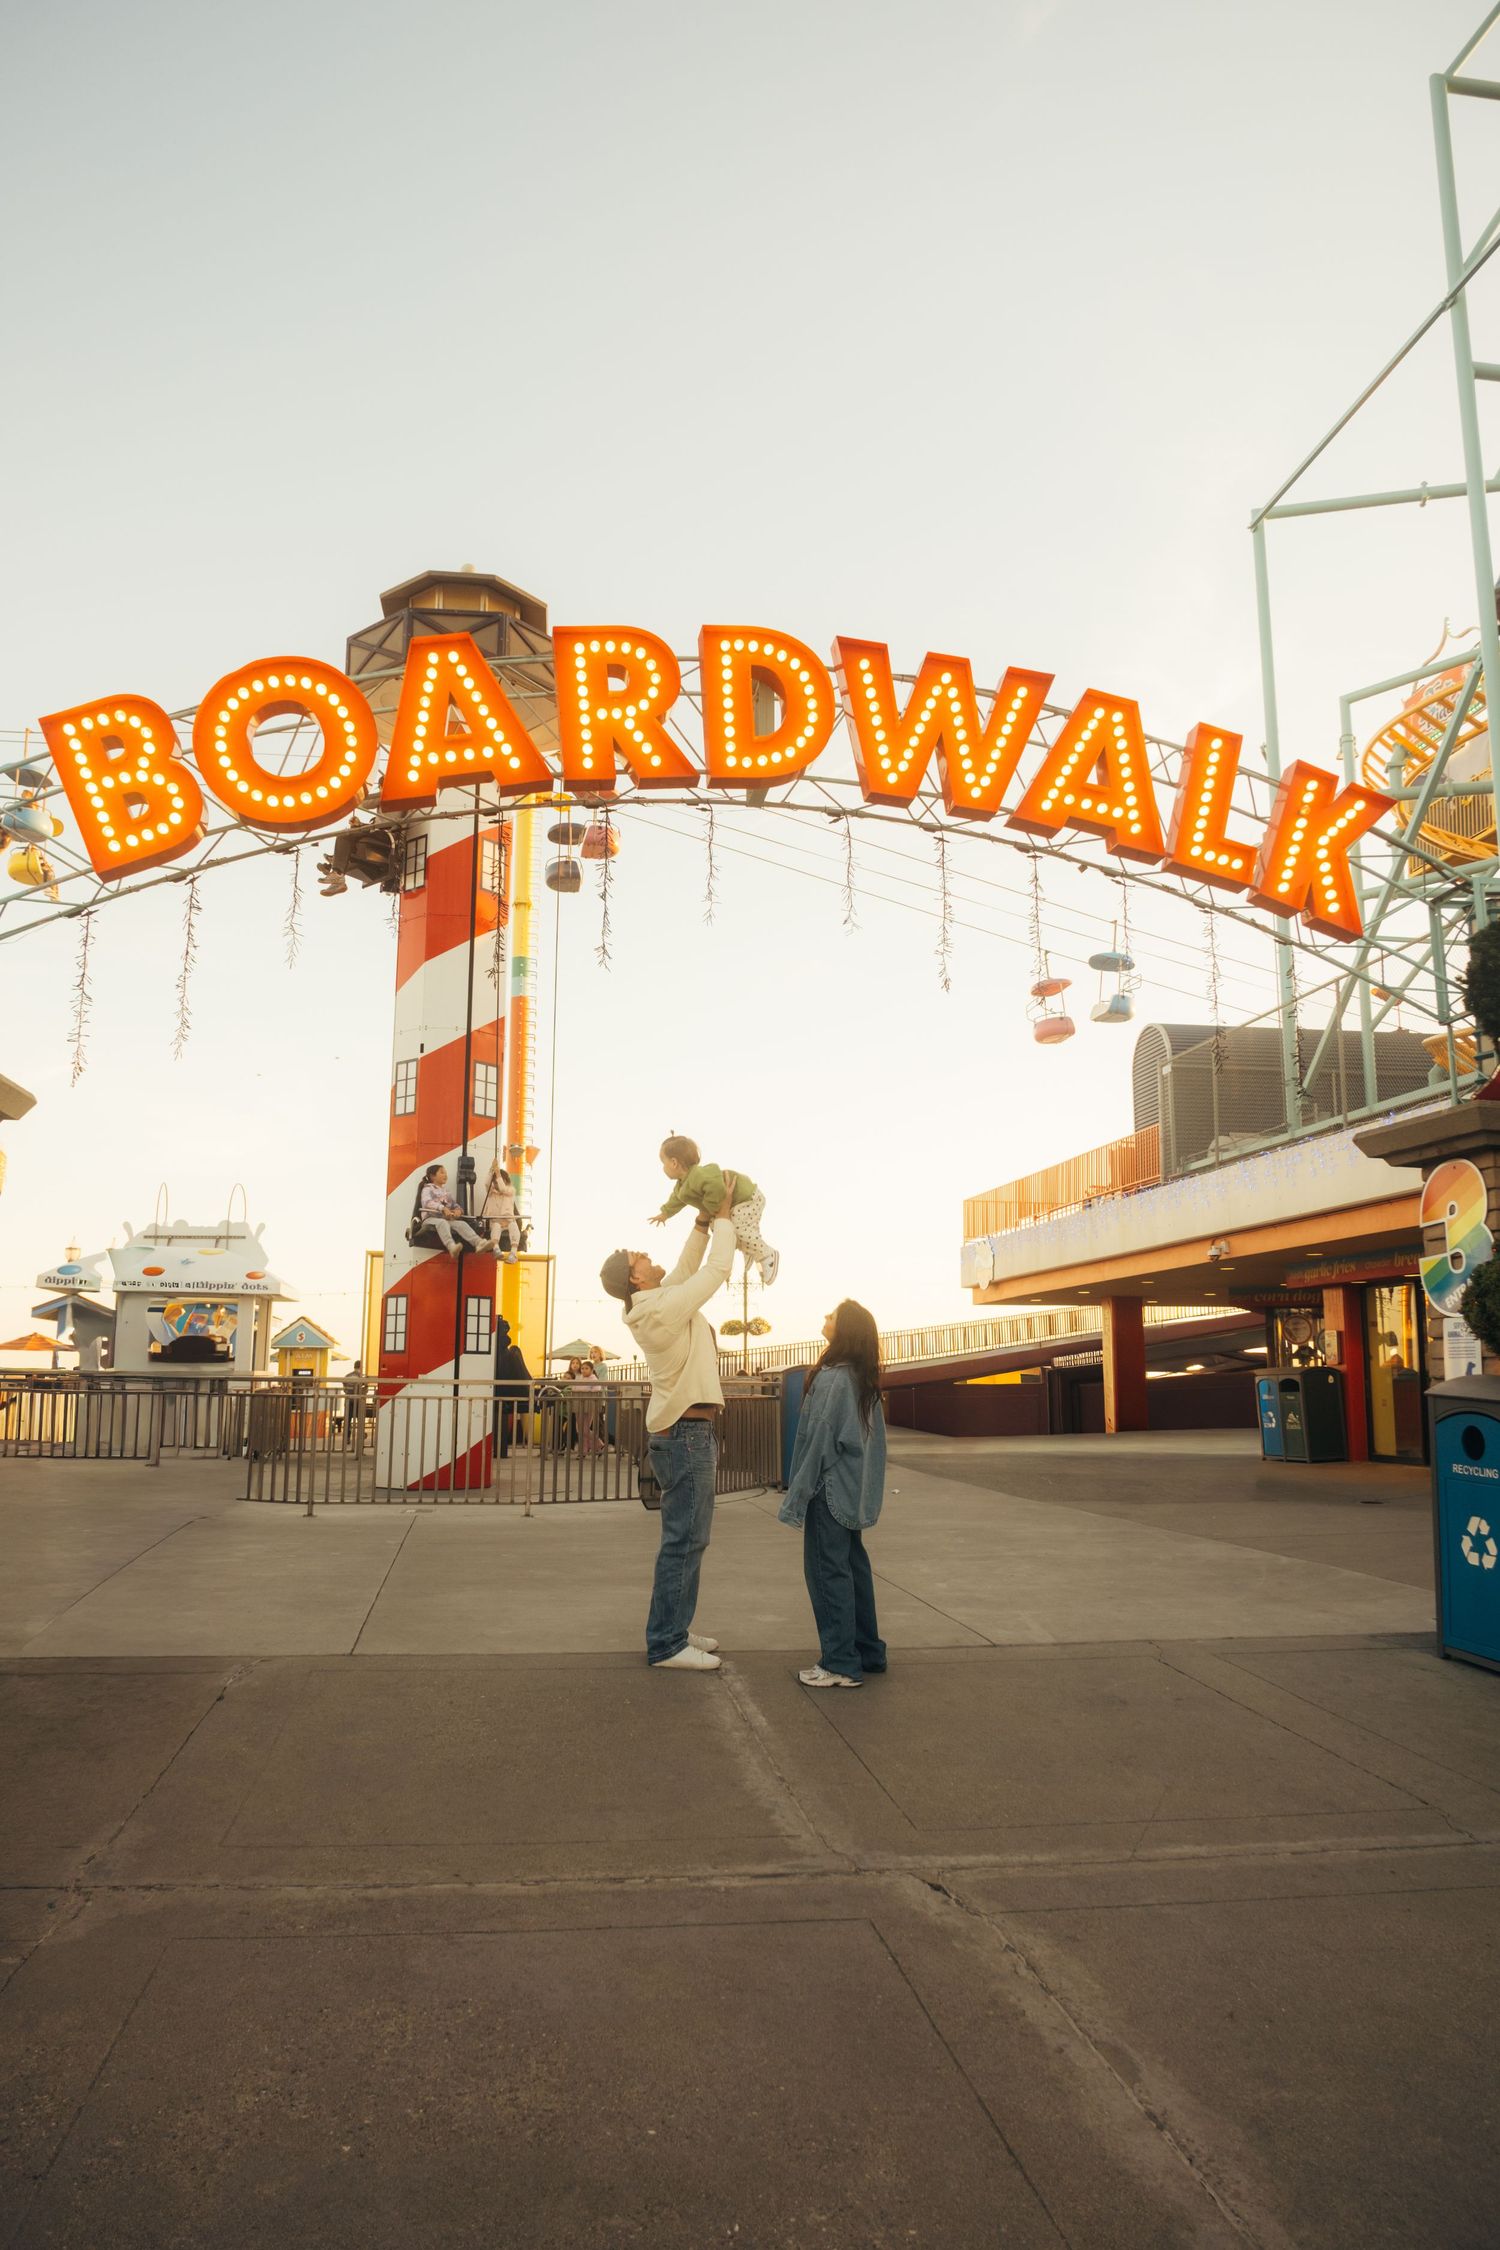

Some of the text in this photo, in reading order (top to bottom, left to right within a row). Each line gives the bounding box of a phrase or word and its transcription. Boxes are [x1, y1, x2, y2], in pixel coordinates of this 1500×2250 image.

[39, 625, 1397, 943] BOARDWALK
[241, 1282, 269, 1291] dots
[1452, 1463, 1499, 1479] RECYCLING
